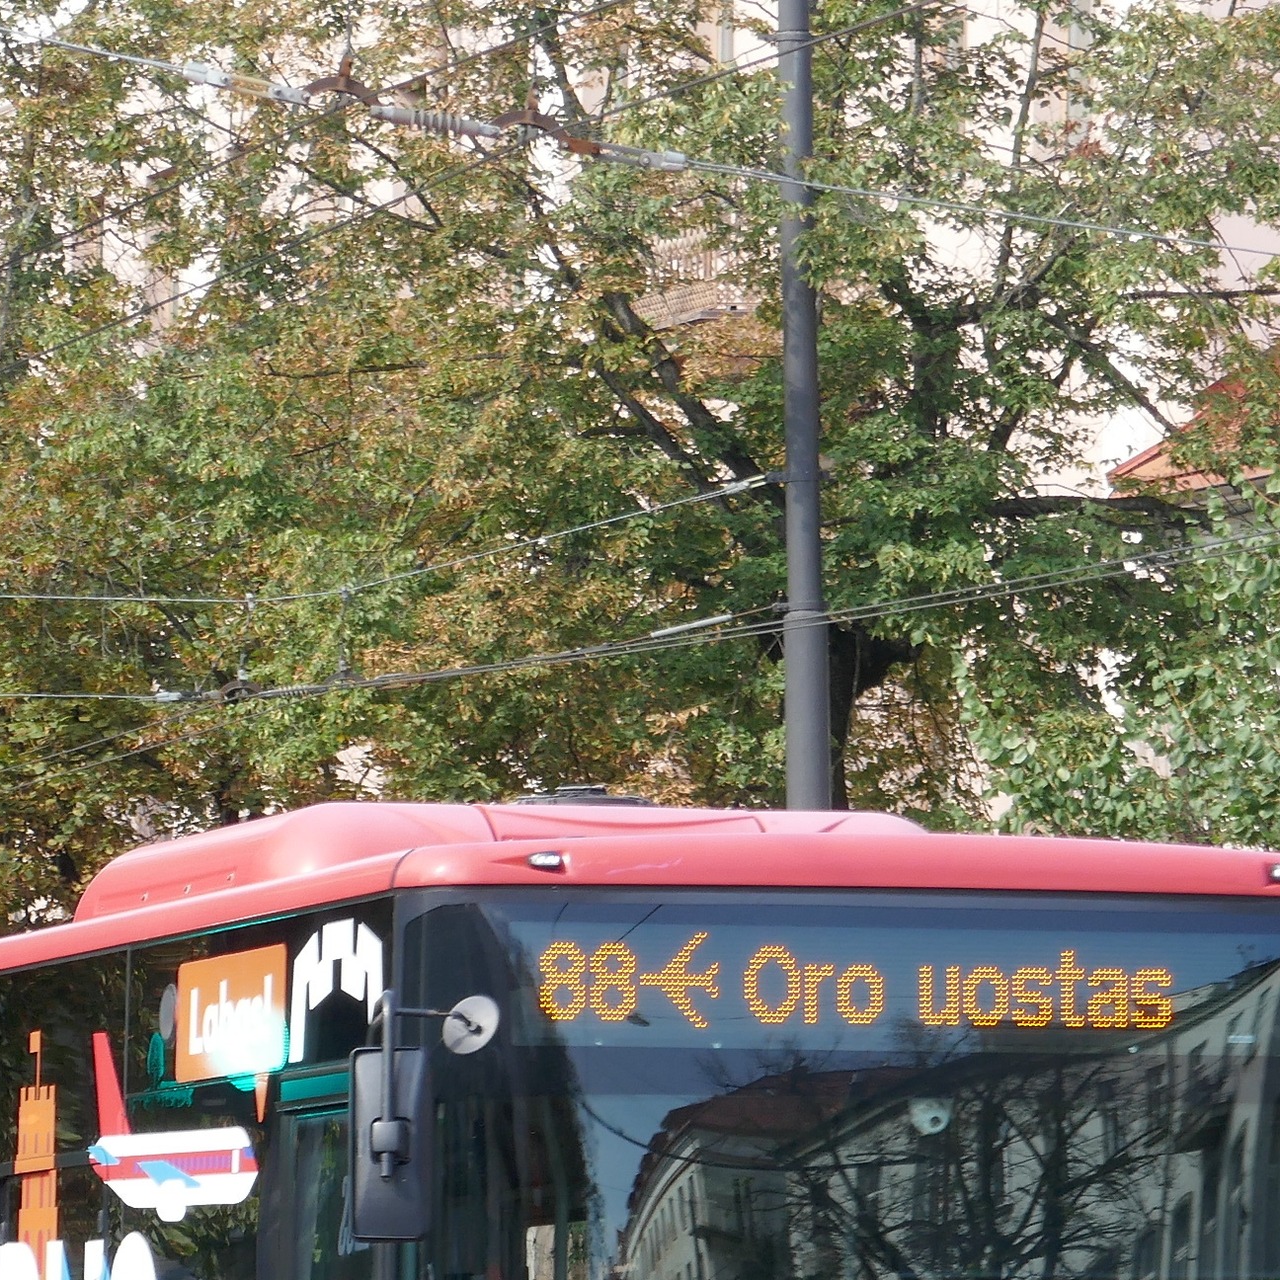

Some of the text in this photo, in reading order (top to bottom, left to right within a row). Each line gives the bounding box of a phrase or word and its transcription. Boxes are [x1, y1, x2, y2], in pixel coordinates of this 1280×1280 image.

[539, 941, 1174, 1029] 88 Oro uostas
